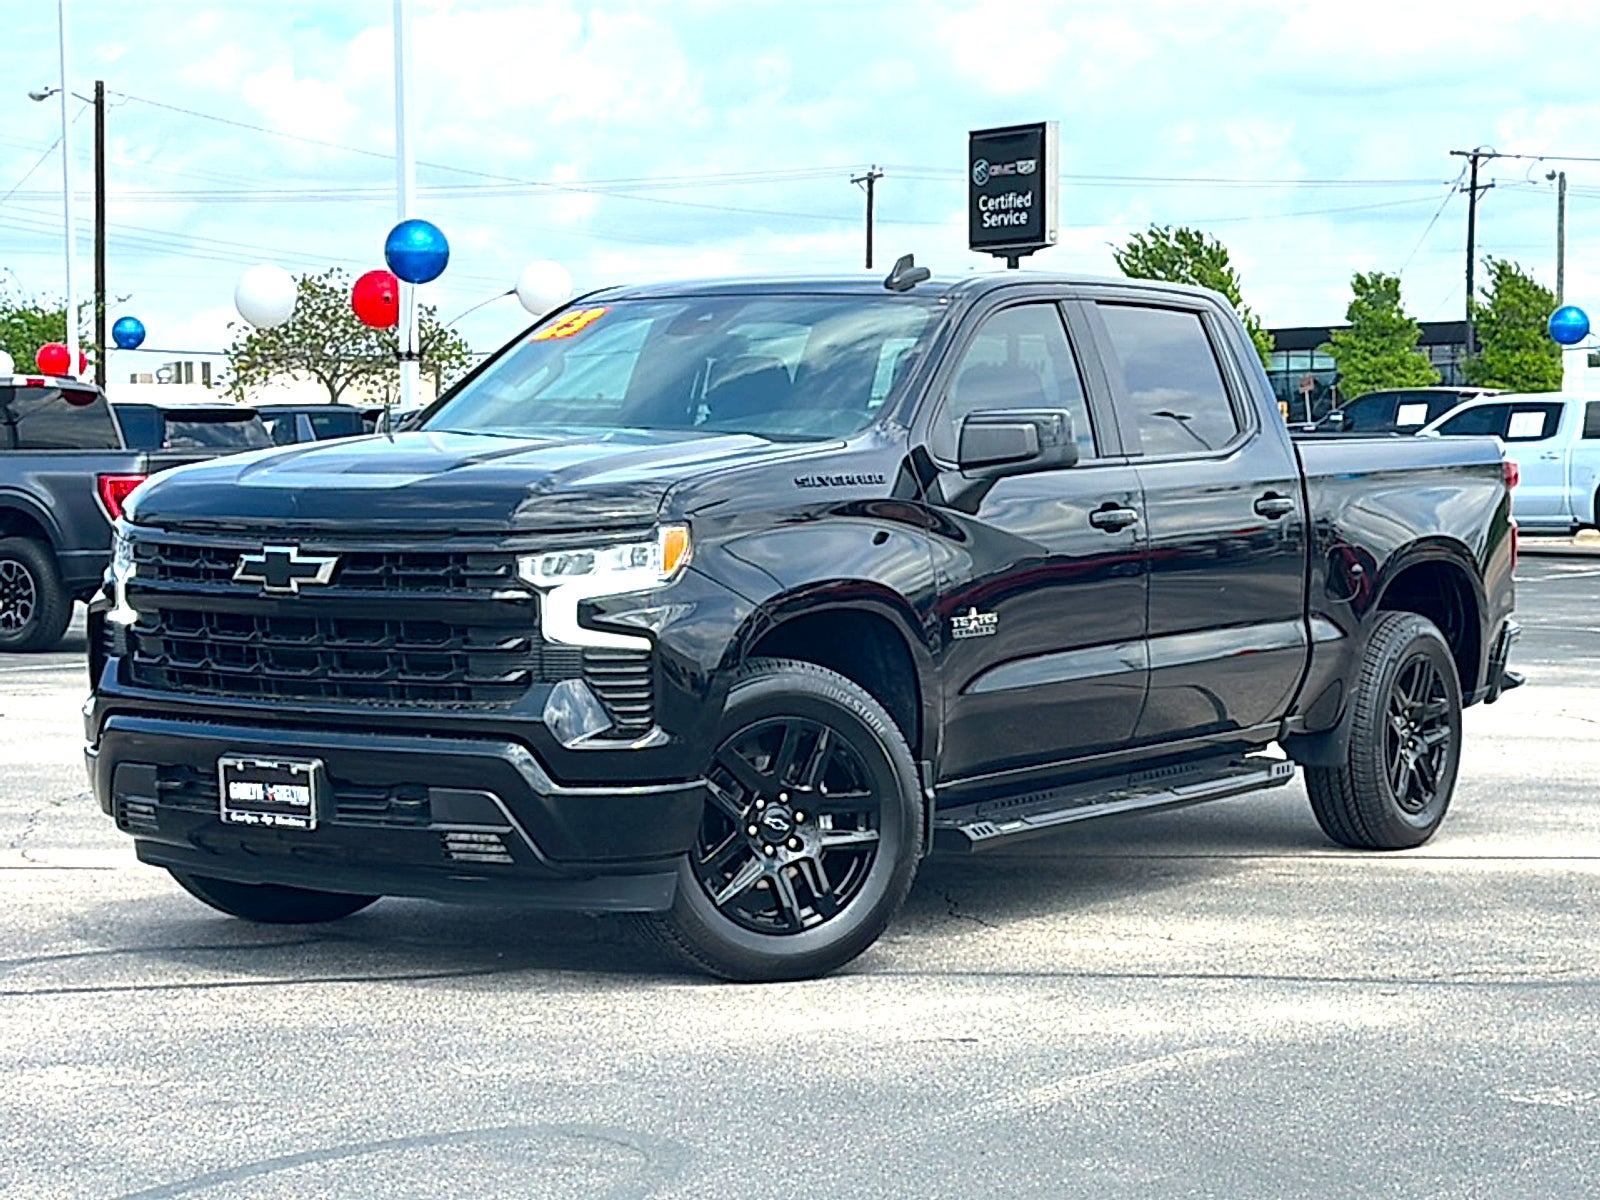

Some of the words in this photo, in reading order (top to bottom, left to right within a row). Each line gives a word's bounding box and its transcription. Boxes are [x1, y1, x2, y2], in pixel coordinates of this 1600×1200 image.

[978, 190, 1032, 211] Certified
[982, 209, 1028, 228] Service
[808, 682, 888, 738] IDGESTONE
